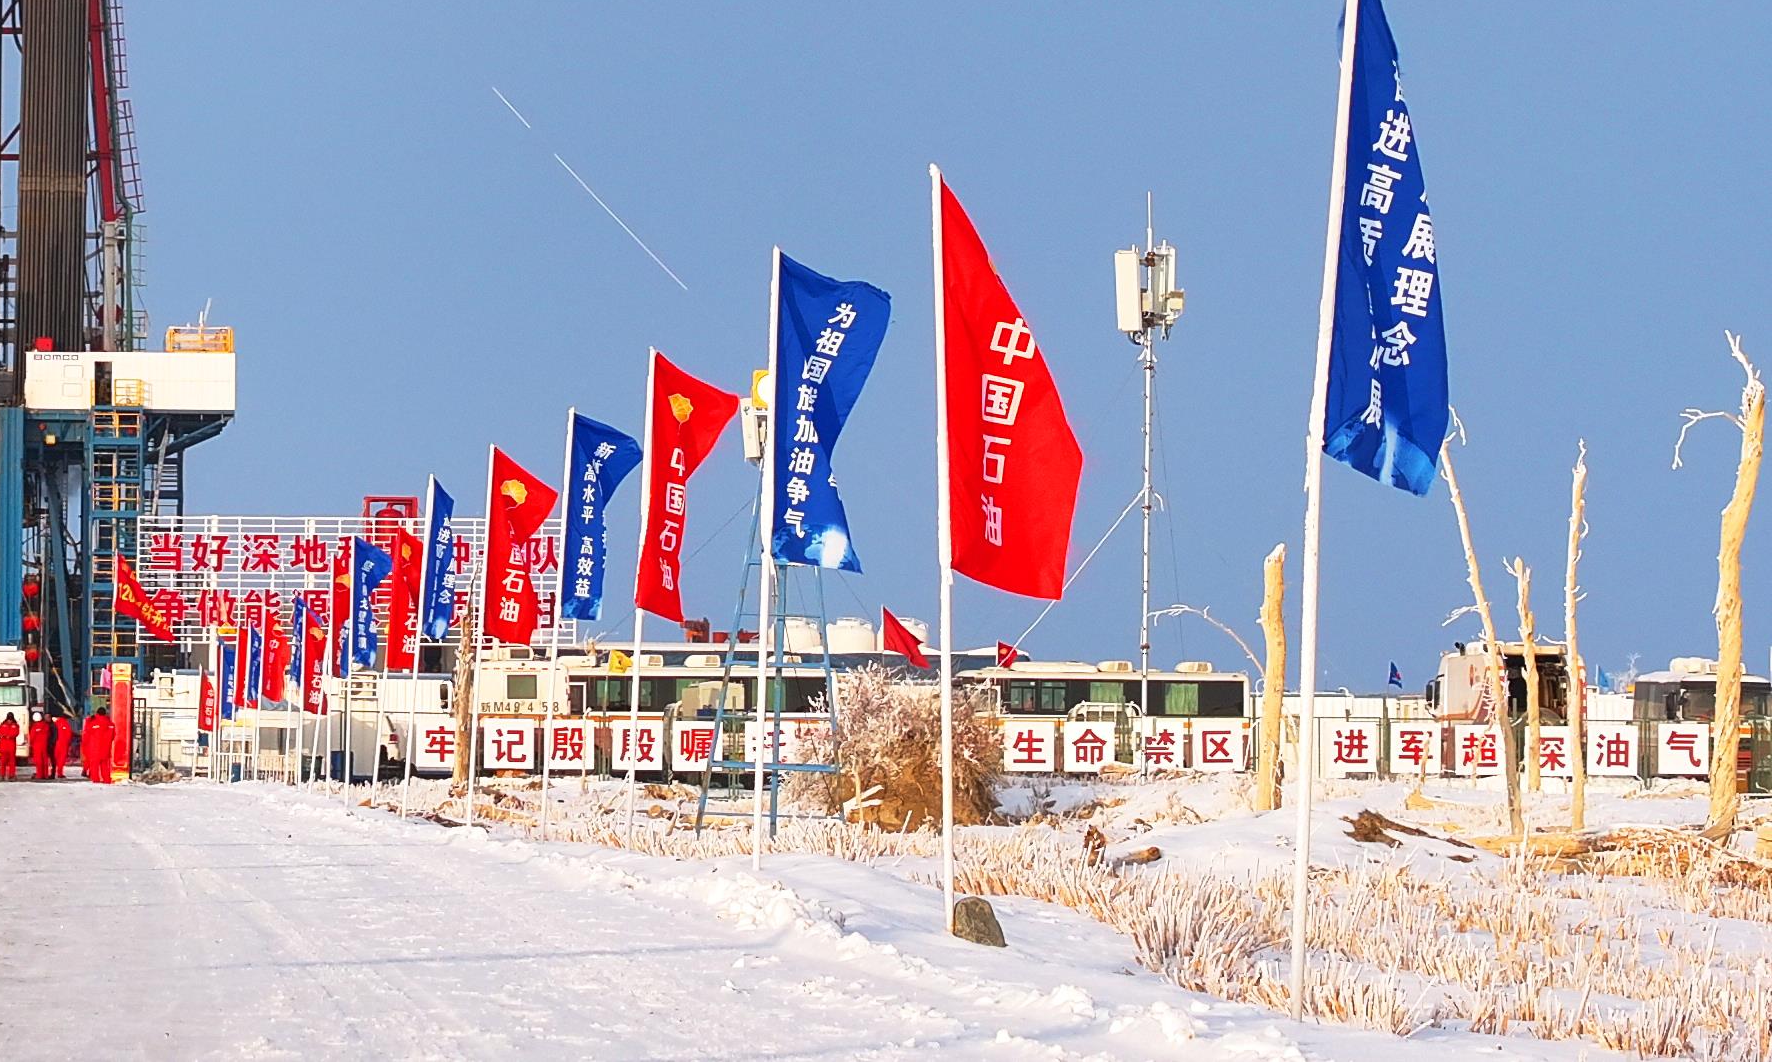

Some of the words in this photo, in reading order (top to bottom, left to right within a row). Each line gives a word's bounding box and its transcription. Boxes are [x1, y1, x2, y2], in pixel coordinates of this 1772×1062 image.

[980, 317, 1036, 547] 中国石油
[659, 447, 686, 591] 中国石油
[498, 542, 528, 623] 国石油
[573, 536, 595, 598] 高效益
[1012, 728, 1234, 764] 生命禁区
